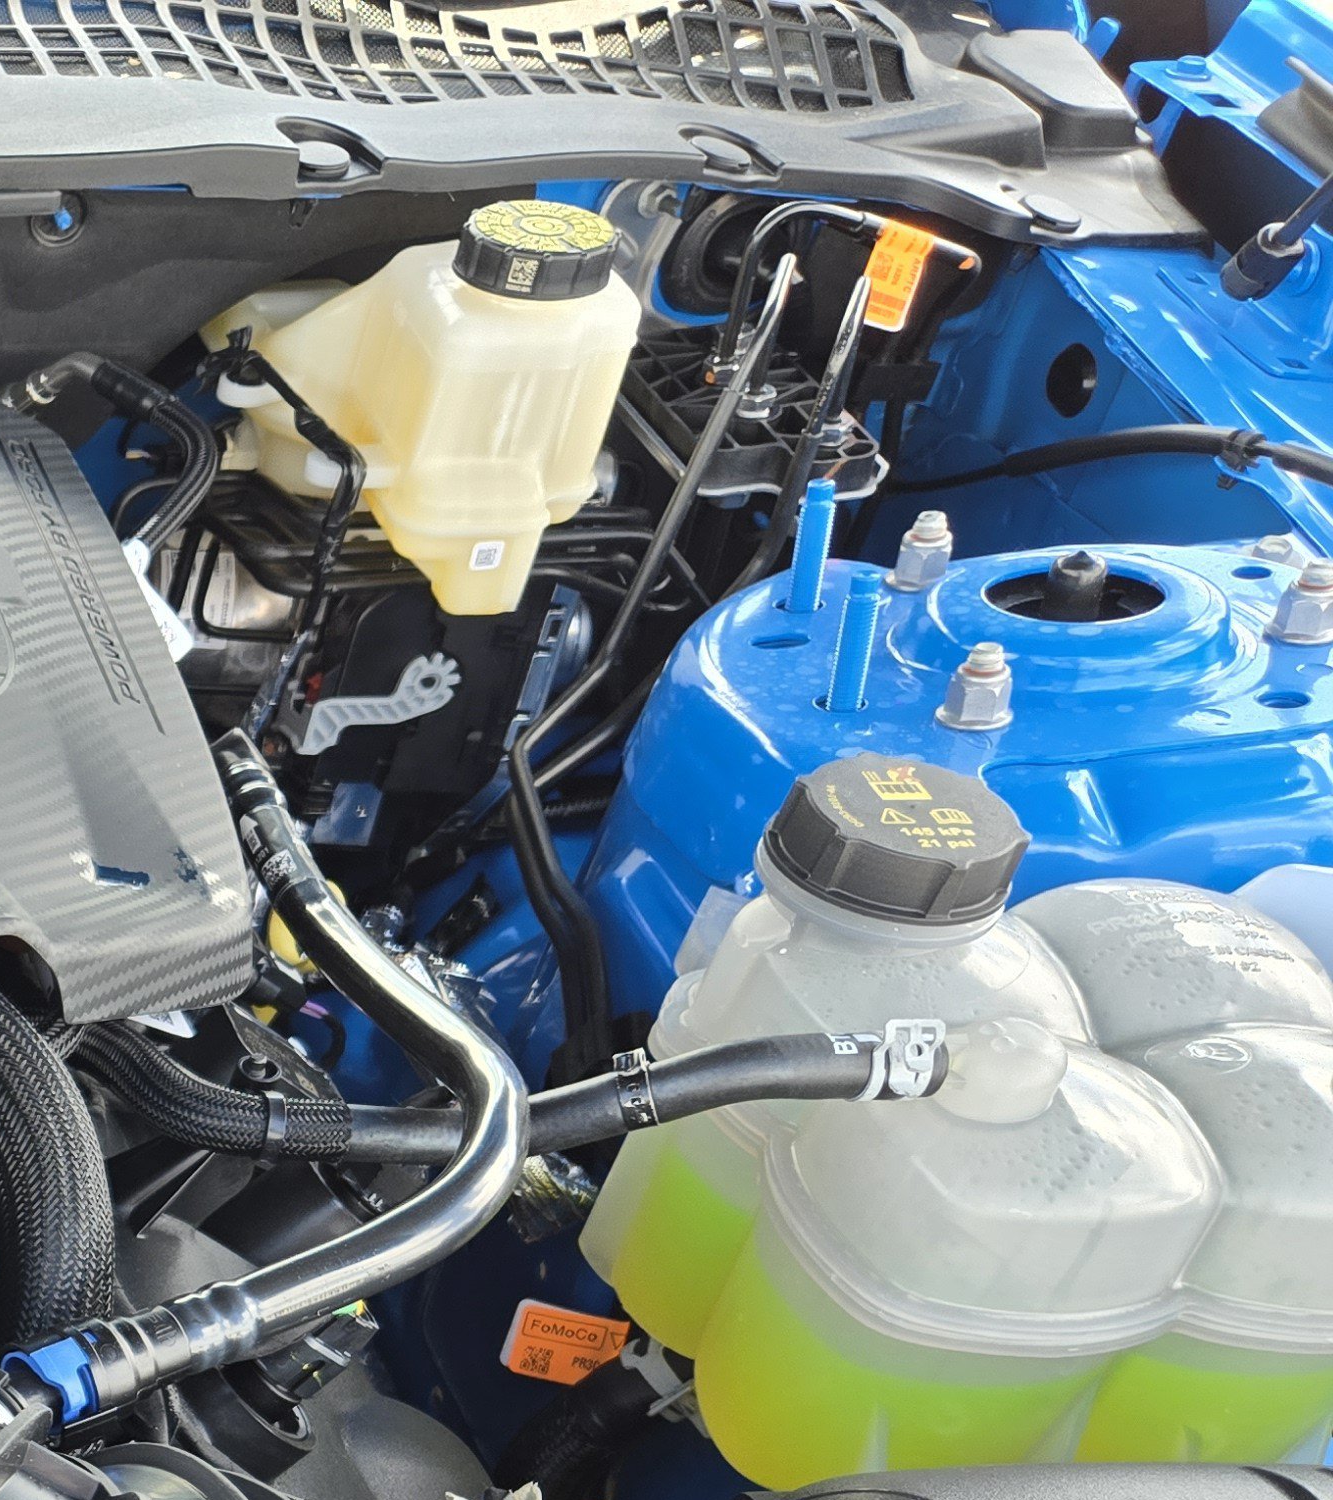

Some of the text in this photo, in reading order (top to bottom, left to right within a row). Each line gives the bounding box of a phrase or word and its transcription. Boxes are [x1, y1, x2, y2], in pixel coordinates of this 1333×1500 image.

[7, 438, 141, 705] POWERED BY FORD
[937, 827, 976, 837] kPa
[918, 838, 942, 848] 21
[530, 1318, 599, 1343] FoMoCo
